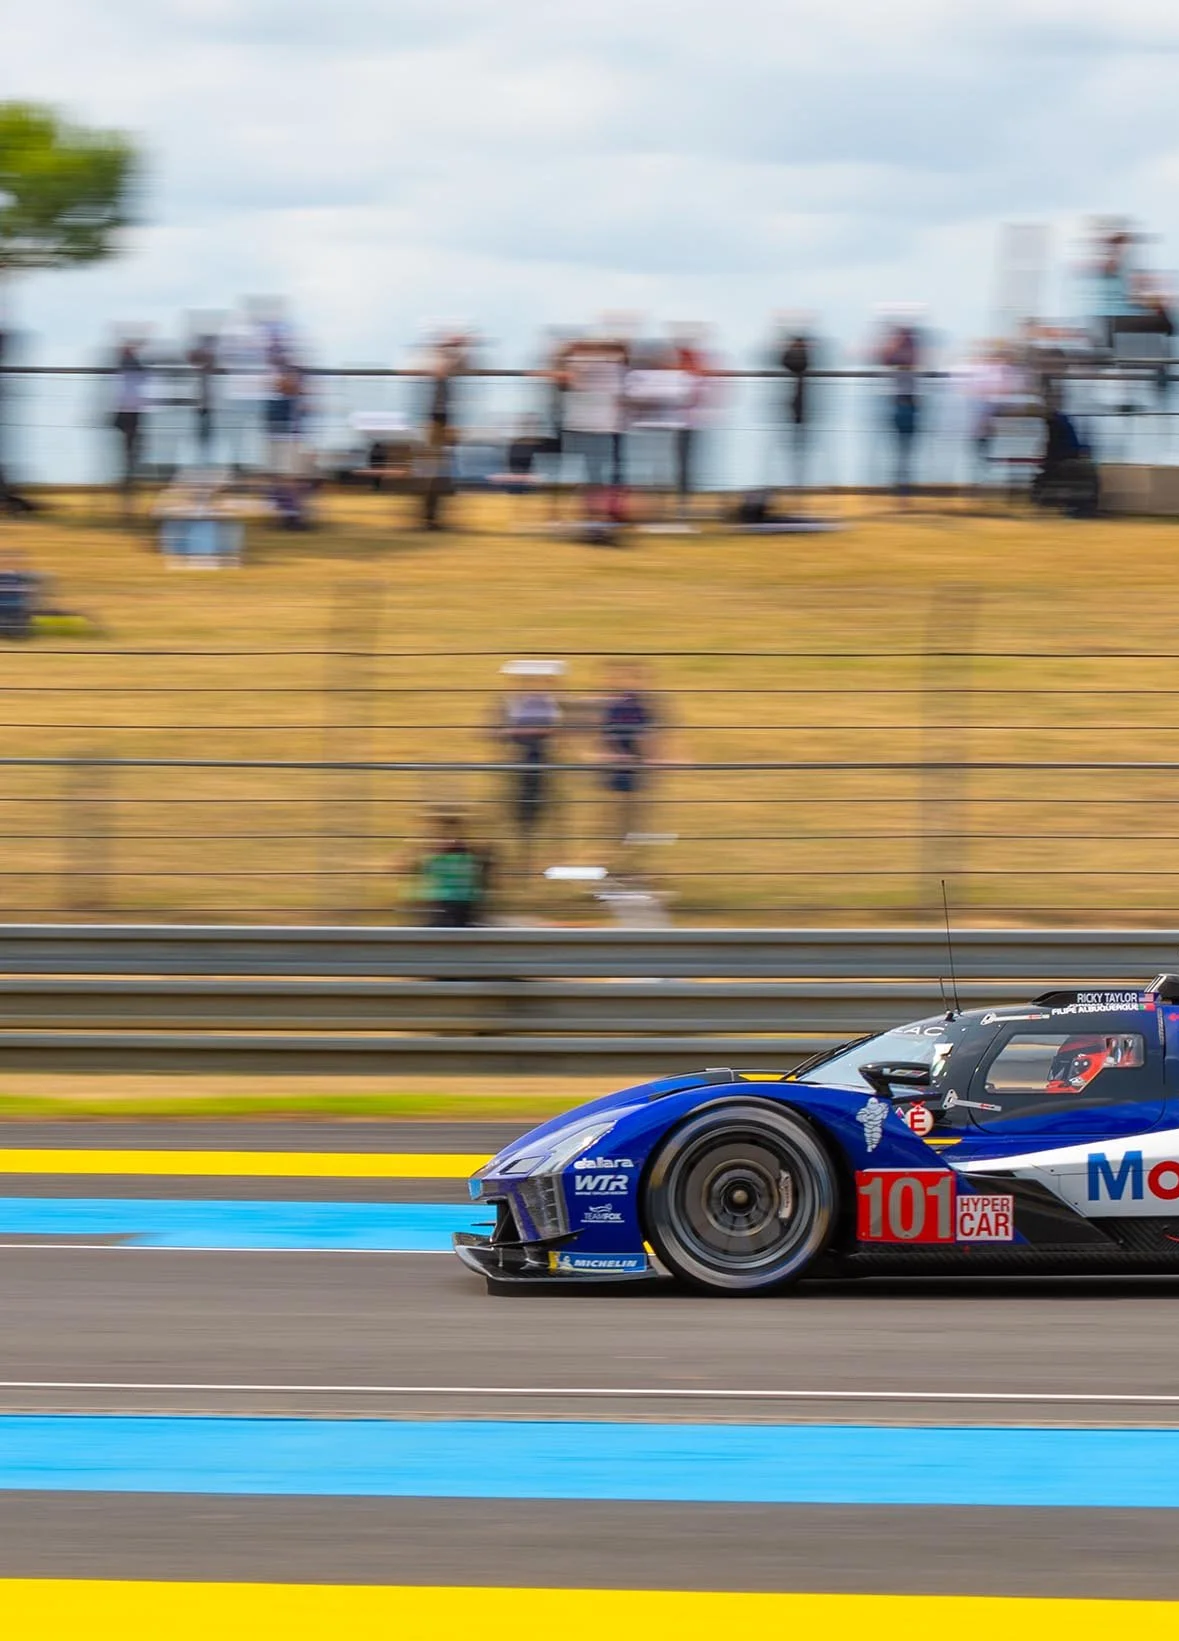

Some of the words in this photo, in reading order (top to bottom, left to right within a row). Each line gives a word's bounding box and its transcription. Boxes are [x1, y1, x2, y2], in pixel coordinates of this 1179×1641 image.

[1076, 992, 1102, 1003] RICKY
[1104, 992, 1138, 1003] TAYLOR
[574, 1157, 635, 1169] dallara
[575, 1174, 629, 1191] WTR
[859, 1176, 953, 1240] 101
[960, 1197, 1010, 1212] HYPER
[959, 1213, 1010, 1237] CAR
[574, 1259, 637, 1268] MICHELIN
